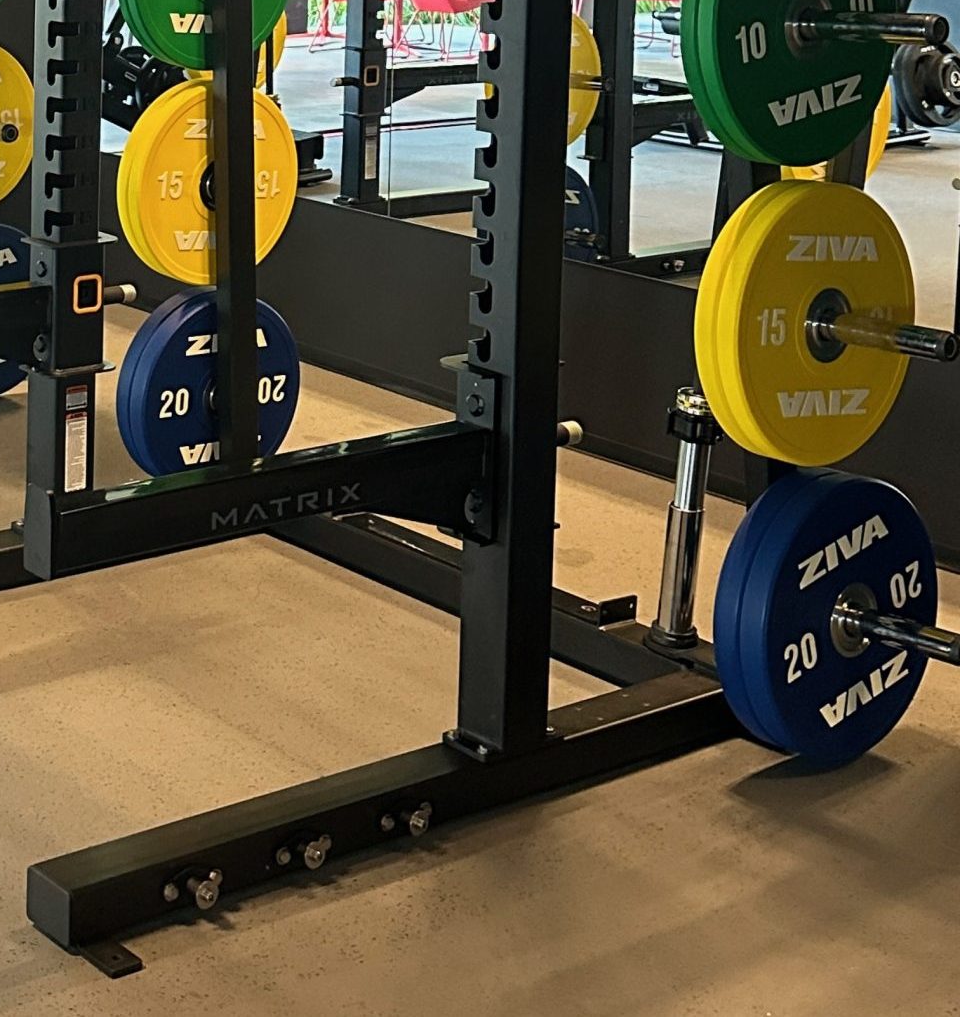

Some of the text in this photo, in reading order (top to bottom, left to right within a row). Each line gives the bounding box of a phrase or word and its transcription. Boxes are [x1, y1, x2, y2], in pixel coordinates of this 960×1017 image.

[169, 13, 212, 34] VA
[735, 22, 767, 64] 10
[768, 74, 862, 127] ZIVA
[183, 119, 266, 140] ZA
[157, 171, 183, 201] 15
[255, 170, 281, 199] 15
[786, 235, 879, 262] ZIVA
[757, 308, 787, 346] 15
[159, 387, 190, 419] 20
[258, 374, 287, 405] 20
[777, 389, 870, 418] ZIVA
[210, 482, 361, 531] MATRIX
[798, 515, 889, 590] ZIVA
[890, 560, 922, 609] 20
[784, 632, 818, 684] 20
[819, 650, 909, 728] ZIVA
